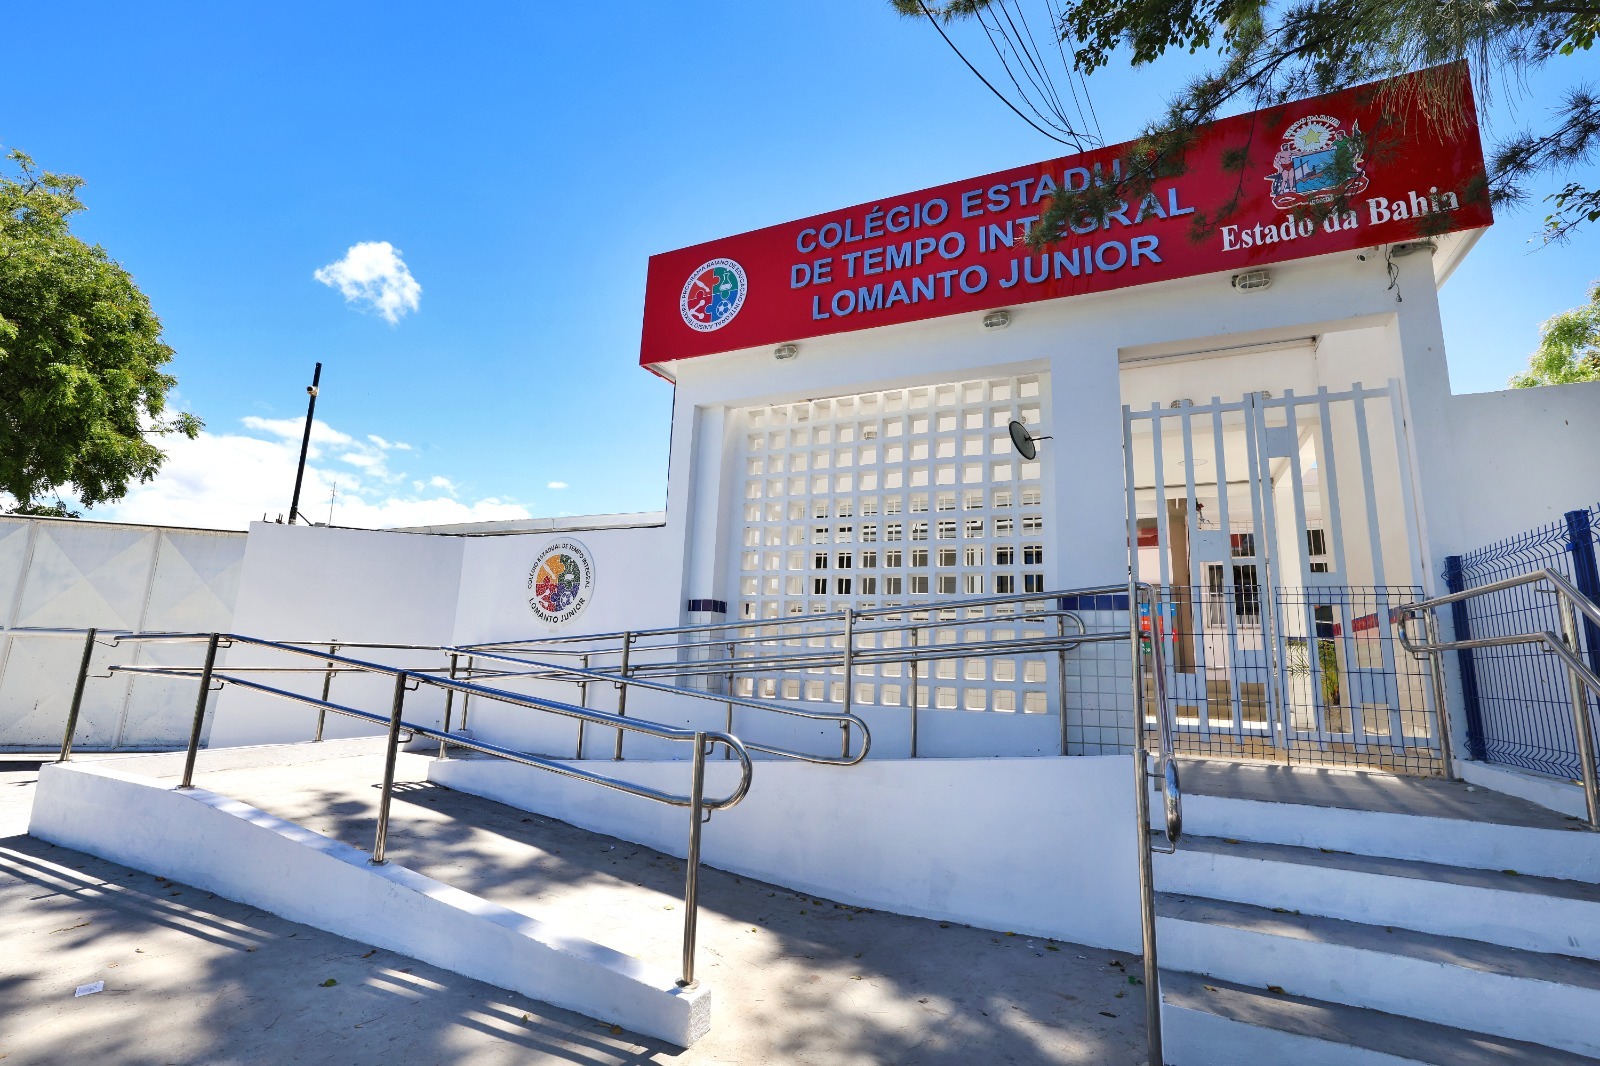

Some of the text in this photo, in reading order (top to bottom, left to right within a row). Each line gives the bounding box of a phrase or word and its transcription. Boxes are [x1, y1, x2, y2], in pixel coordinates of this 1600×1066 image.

[790, 188, 1195, 289] DE TEMPO INTGRAL
[796, 199, 948, 254] COLÉGIO
[1220, 186, 1460, 252] Estado da Bahia
[728, 261, 737, 269] DE
[812, 234, 1163, 321] LOMANTO JUNIOR
[529, 597, 586, 624] LOMANTO JUNIOR
